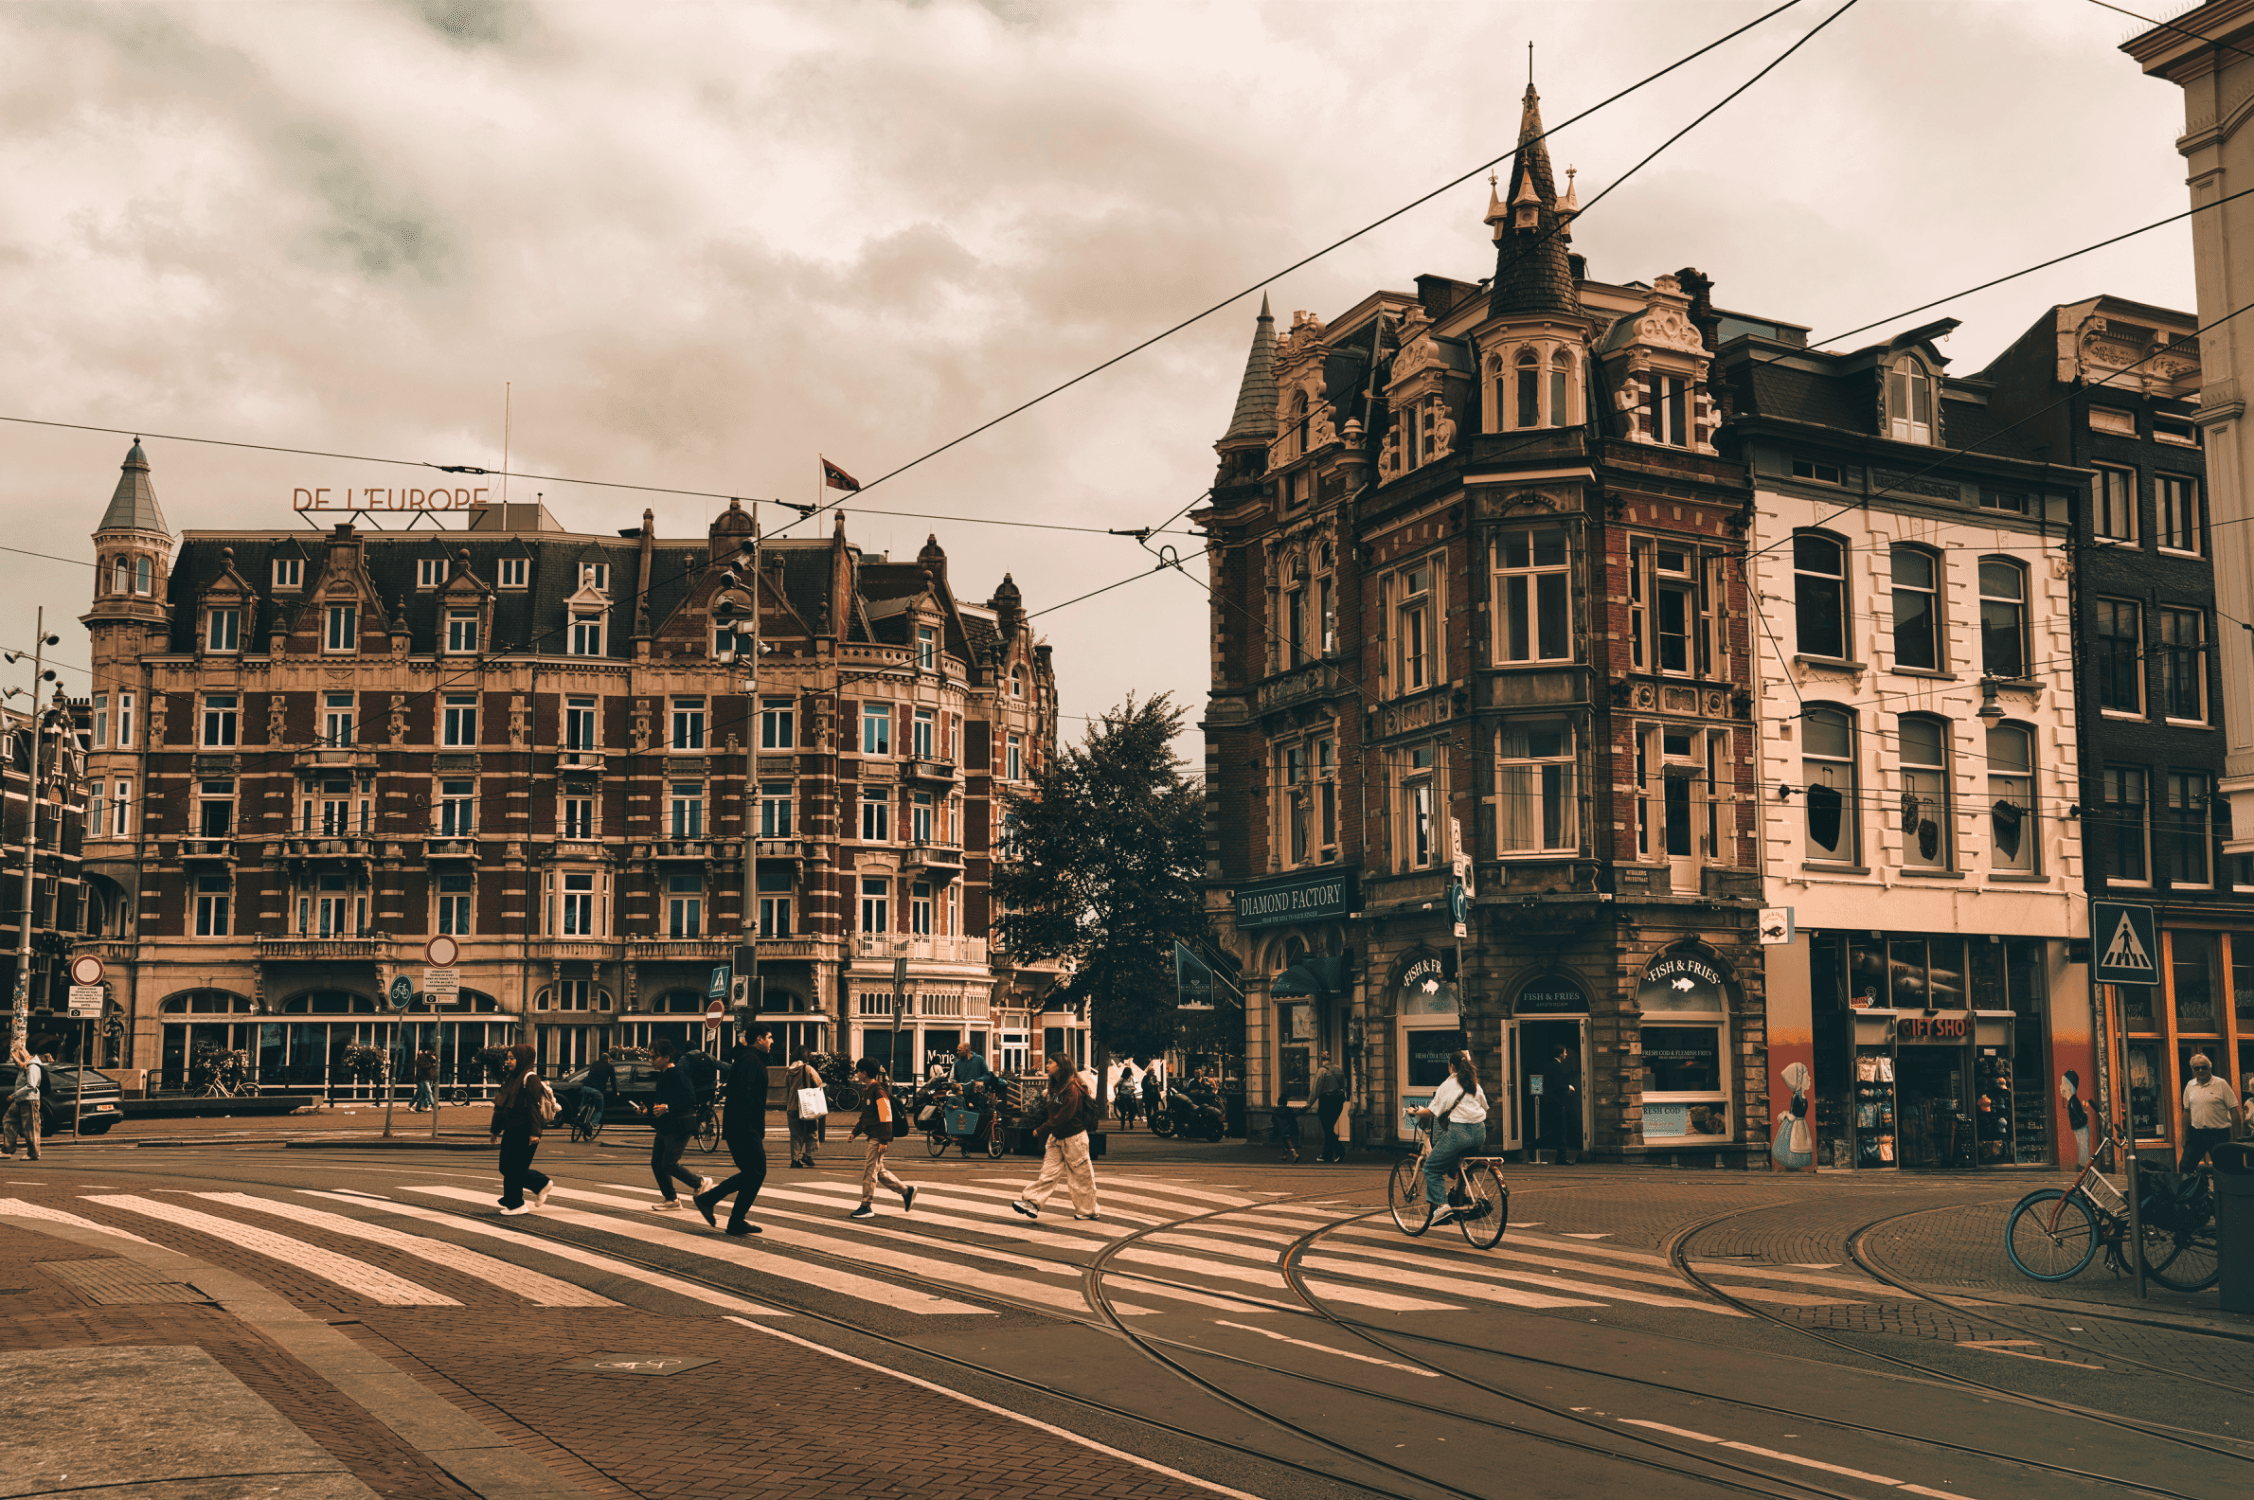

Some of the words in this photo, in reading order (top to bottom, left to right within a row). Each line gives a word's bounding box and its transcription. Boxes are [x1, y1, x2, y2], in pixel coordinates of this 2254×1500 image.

[293, 488, 331, 511] DE
[347, 488, 489, 511] L'EUROPE
[1241, 893, 1289, 916] DIAMOND
[1292, 884, 1341, 909] FACTORY
[1403, 961, 1423, 987] FISH
[1422, 959, 1430, 973] &
[1649, 960, 1675, 982] FISH
[1676, 959, 1686, 972] &
[1687, 960, 1719, 984] FRIES
[1523, 992, 1544, 1001] FISH
[1545, 992, 1553, 1000] &
[1554, 992, 1580, 1000] FRIES
[1901, 1018, 1933, 1036] GIFT
[1936, 1018, 1974, 1036] SHOP
[1643, 1107, 1662, 1115] RESH
[1664, 1107, 1681, 1115] COD
